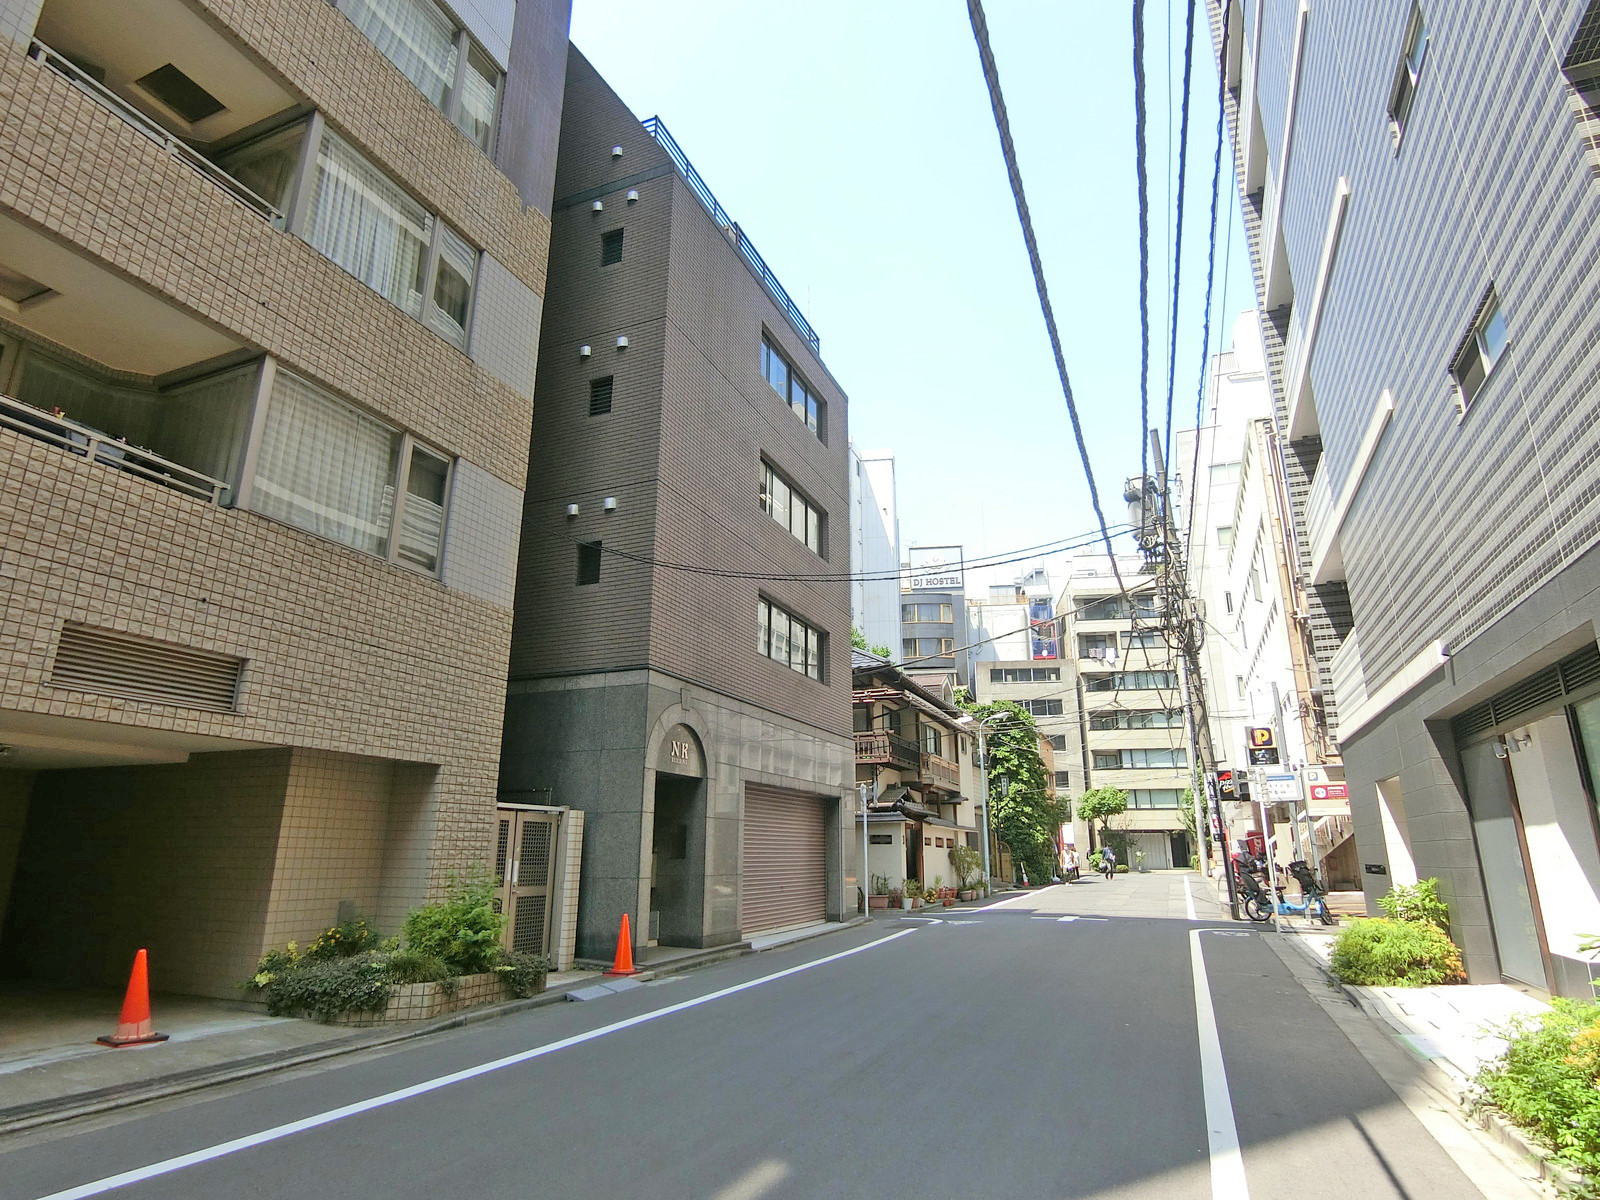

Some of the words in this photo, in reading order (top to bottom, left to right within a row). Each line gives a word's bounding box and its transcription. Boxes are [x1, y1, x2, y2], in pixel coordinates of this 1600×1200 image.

[913, 578, 924, 587] DJ
[925, 577, 961, 586] HOSTEL
[1254, 729, 1270, 745] P
